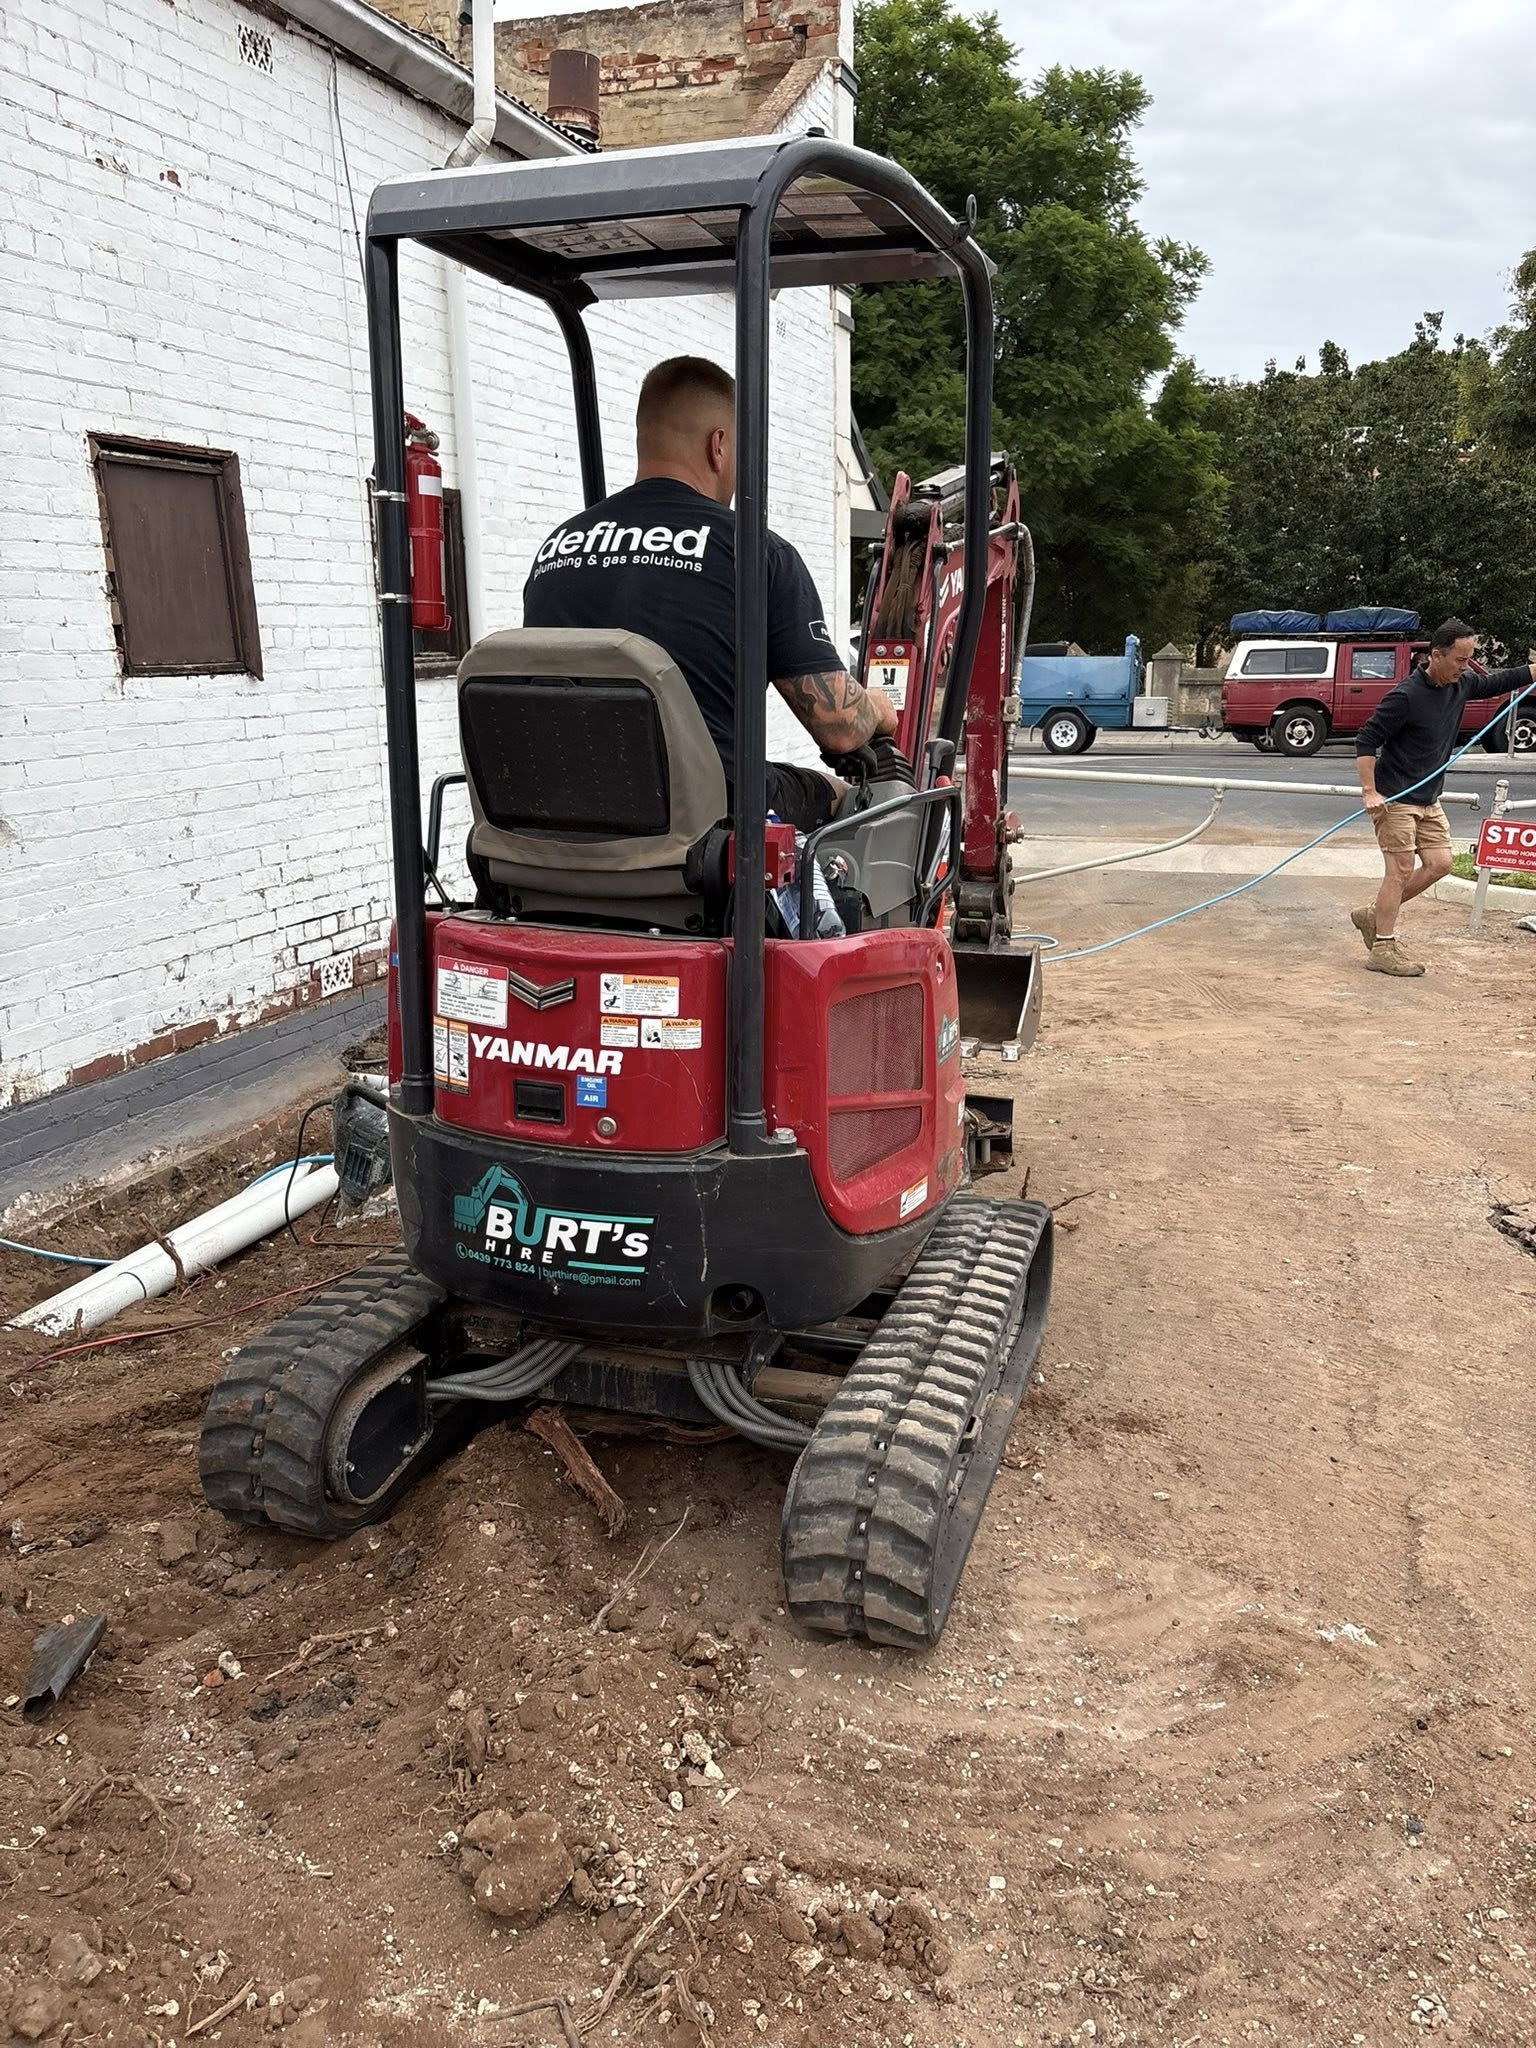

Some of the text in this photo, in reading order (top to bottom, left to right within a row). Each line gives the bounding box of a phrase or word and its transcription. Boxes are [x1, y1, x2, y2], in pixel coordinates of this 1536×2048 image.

[537, 521, 711, 563] defined
[534, 553, 703, 581] plumbing & gas solutions
[1486, 825, 1536, 847] STO
[1486, 856, 1517, 864] PROCEED
[460, 963, 489, 976] DANGER
[609, 1017, 637, 1025] WARNING
[470, 1033, 623, 1075] YANMAR
[583, 1094, 599, 1103] AIR
[468, 1249, 536, 1274] 0439 773 824
[485, 1239, 554, 1264] HIRE
[542, 1266, 641, 1286] burthire@gmail.com
